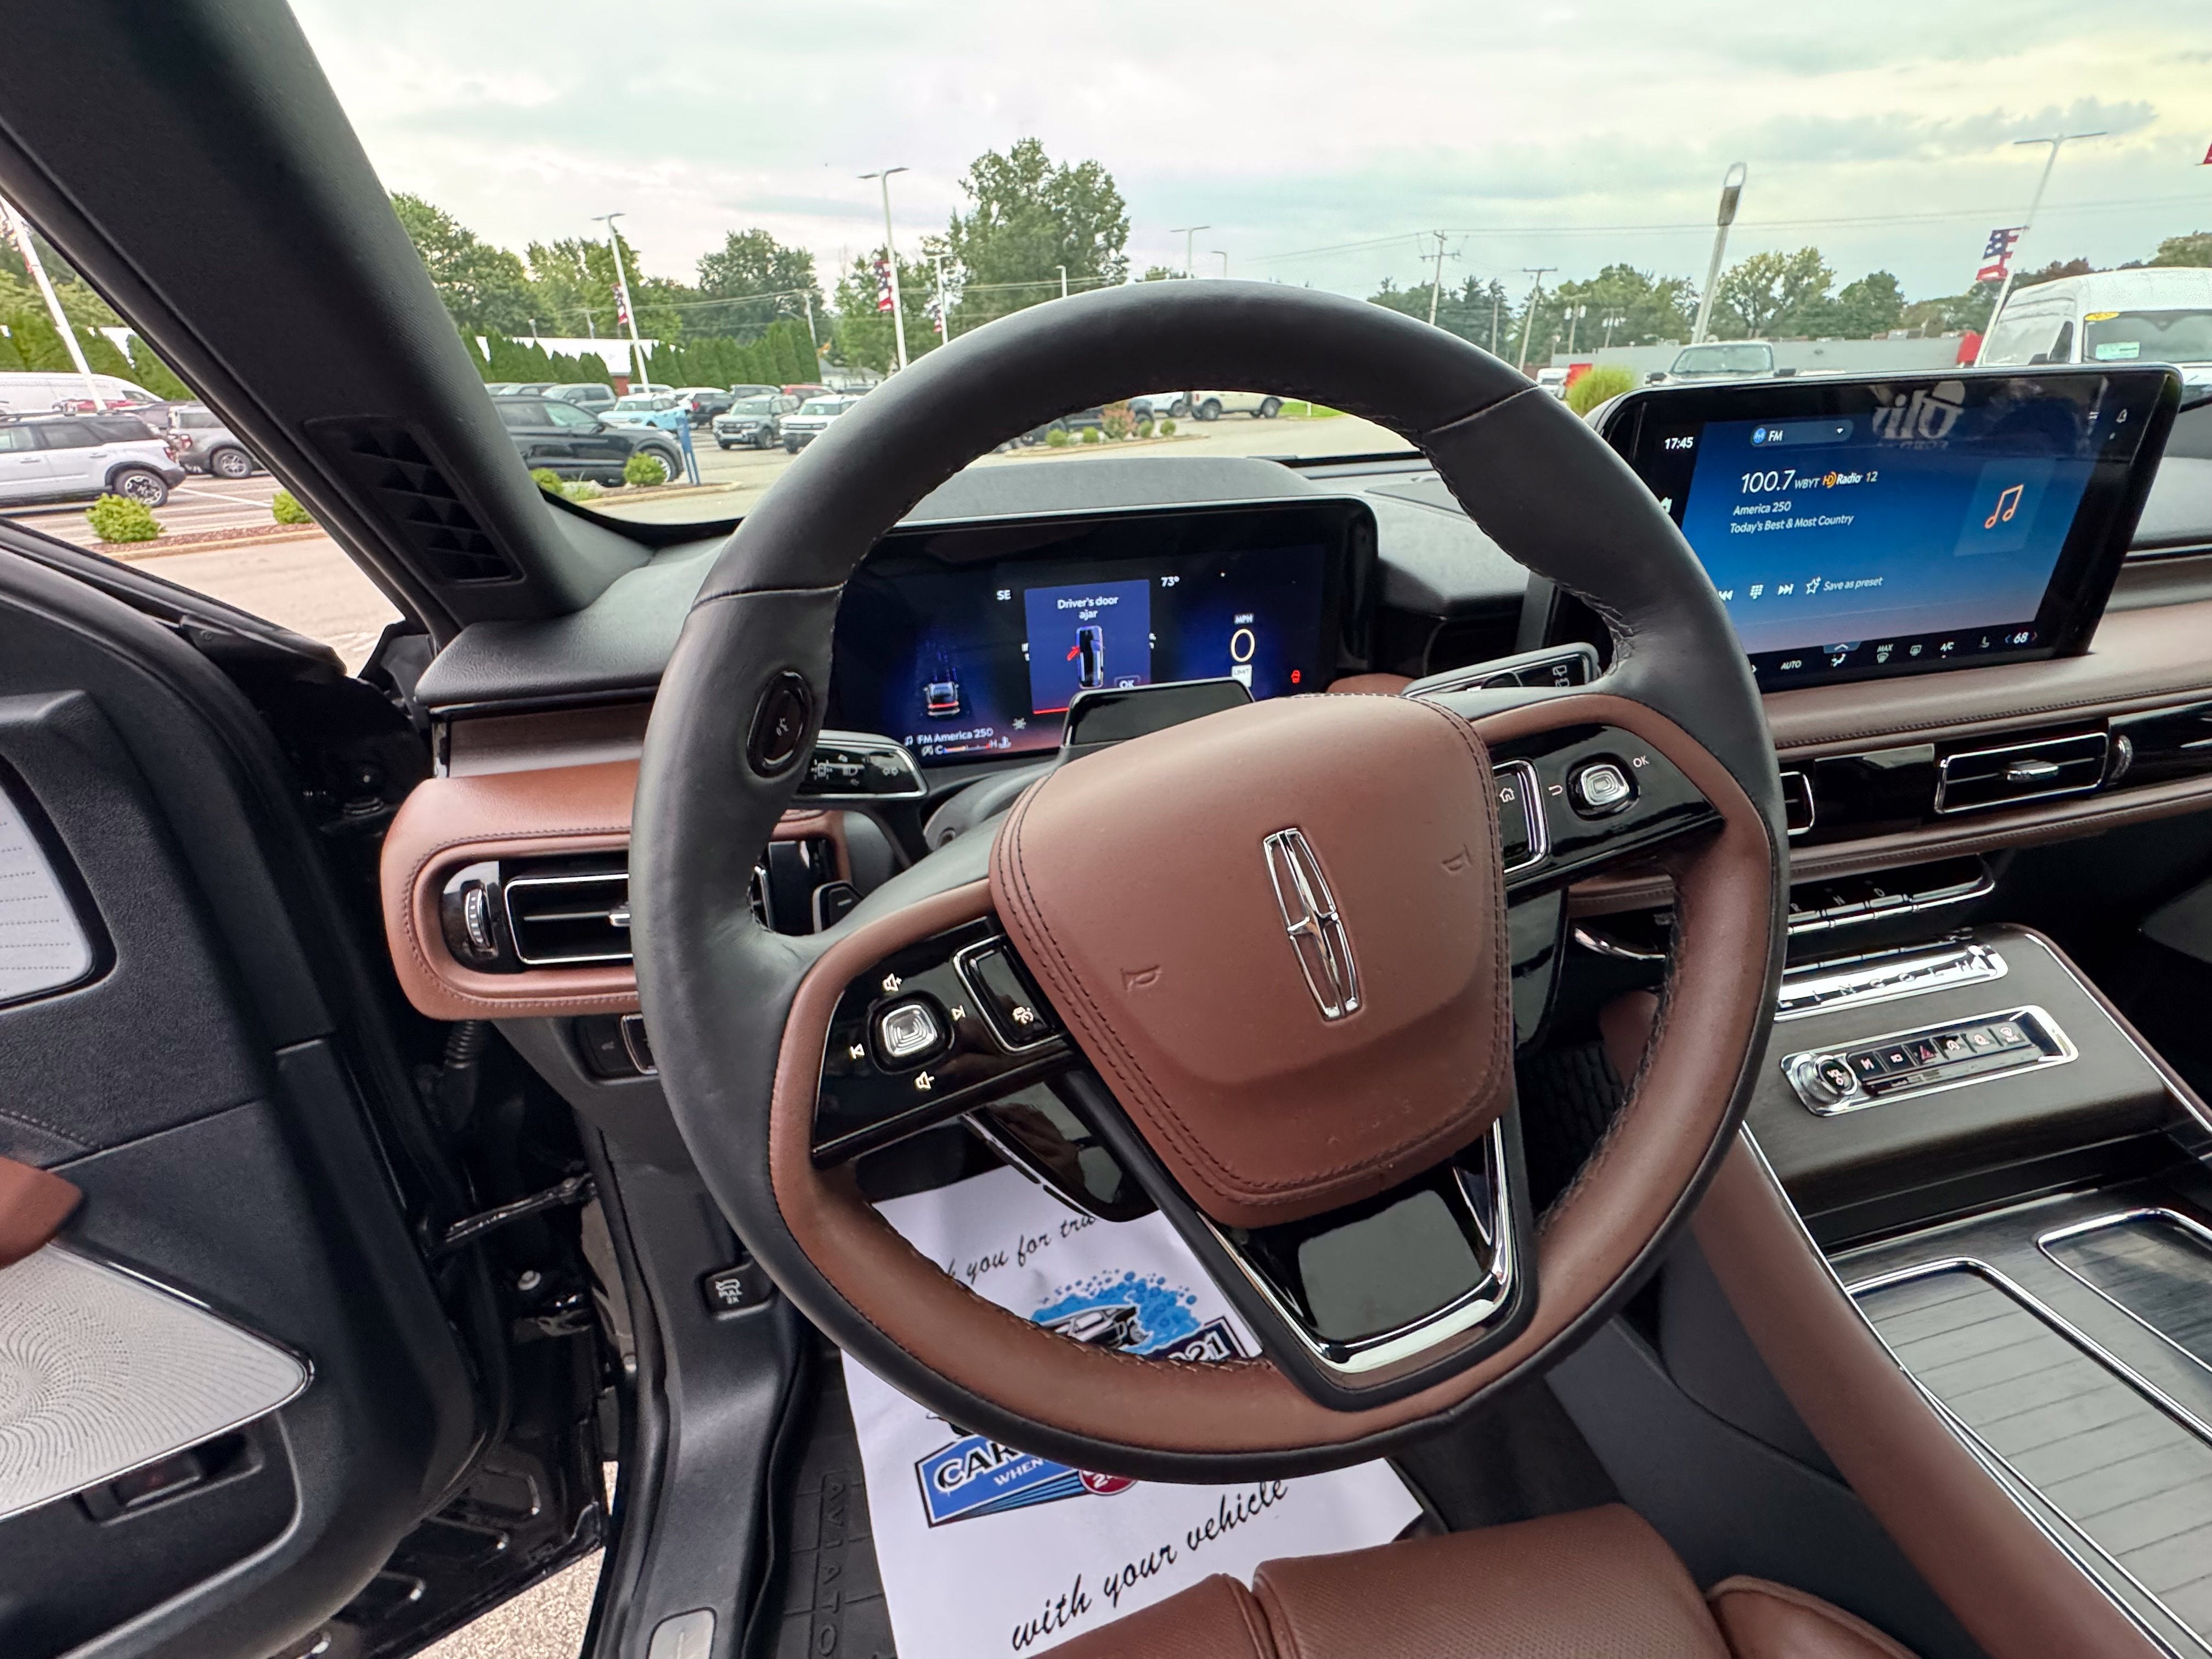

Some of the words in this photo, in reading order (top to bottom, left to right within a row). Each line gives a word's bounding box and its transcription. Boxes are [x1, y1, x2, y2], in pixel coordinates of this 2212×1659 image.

[1768, 430, 1783, 442] FM
[1664, 437, 1694, 450] 17:45
[1741, 470, 1796, 494] 100.7
[1795, 478, 1820, 489] WBYT
[1836, 473, 1863, 485] Radio
[1733, 504, 1771, 516] America
[1772, 501, 1792, 512] 250
[1730, 521, 1763, 534] Today's
[1764, 519, 1785, 531] Best
[1786, 518, 1793, 529] &
[1794, 517, 1817, 528] Most
[1818, 514, 1855, 526] Country
[1822, 580, 1843, 591] Save
[1855, 577, 1883, 590] preset
[996, 589, 1012, 601] SE
[1057, 597, 1094, 610] Driver's
[1096, 595, 1119, 606] door
[1079, 610, 1098, 621] ajar
[1235, 613, 1254, 624] MPH
[2013, 631, 2029, 644] 68
[1877, 644, 1893, 653] MAX
[1780, 660, 1802, 671] AUTO
[916, 734, 932, 745] FM
[934, 731, 973, 743] America
[973, 727, 994, 738] 250
[1633, 755, 1650, 768] OK
[966, 1251, 1009, 1285] you
[1017, 1234, 1052, 1267] for
[1013, 1573, 1092, 1651] with
[1104, 1544, 1177, 1608] your
[1187, 1480, 1289, 1550] vehicle
